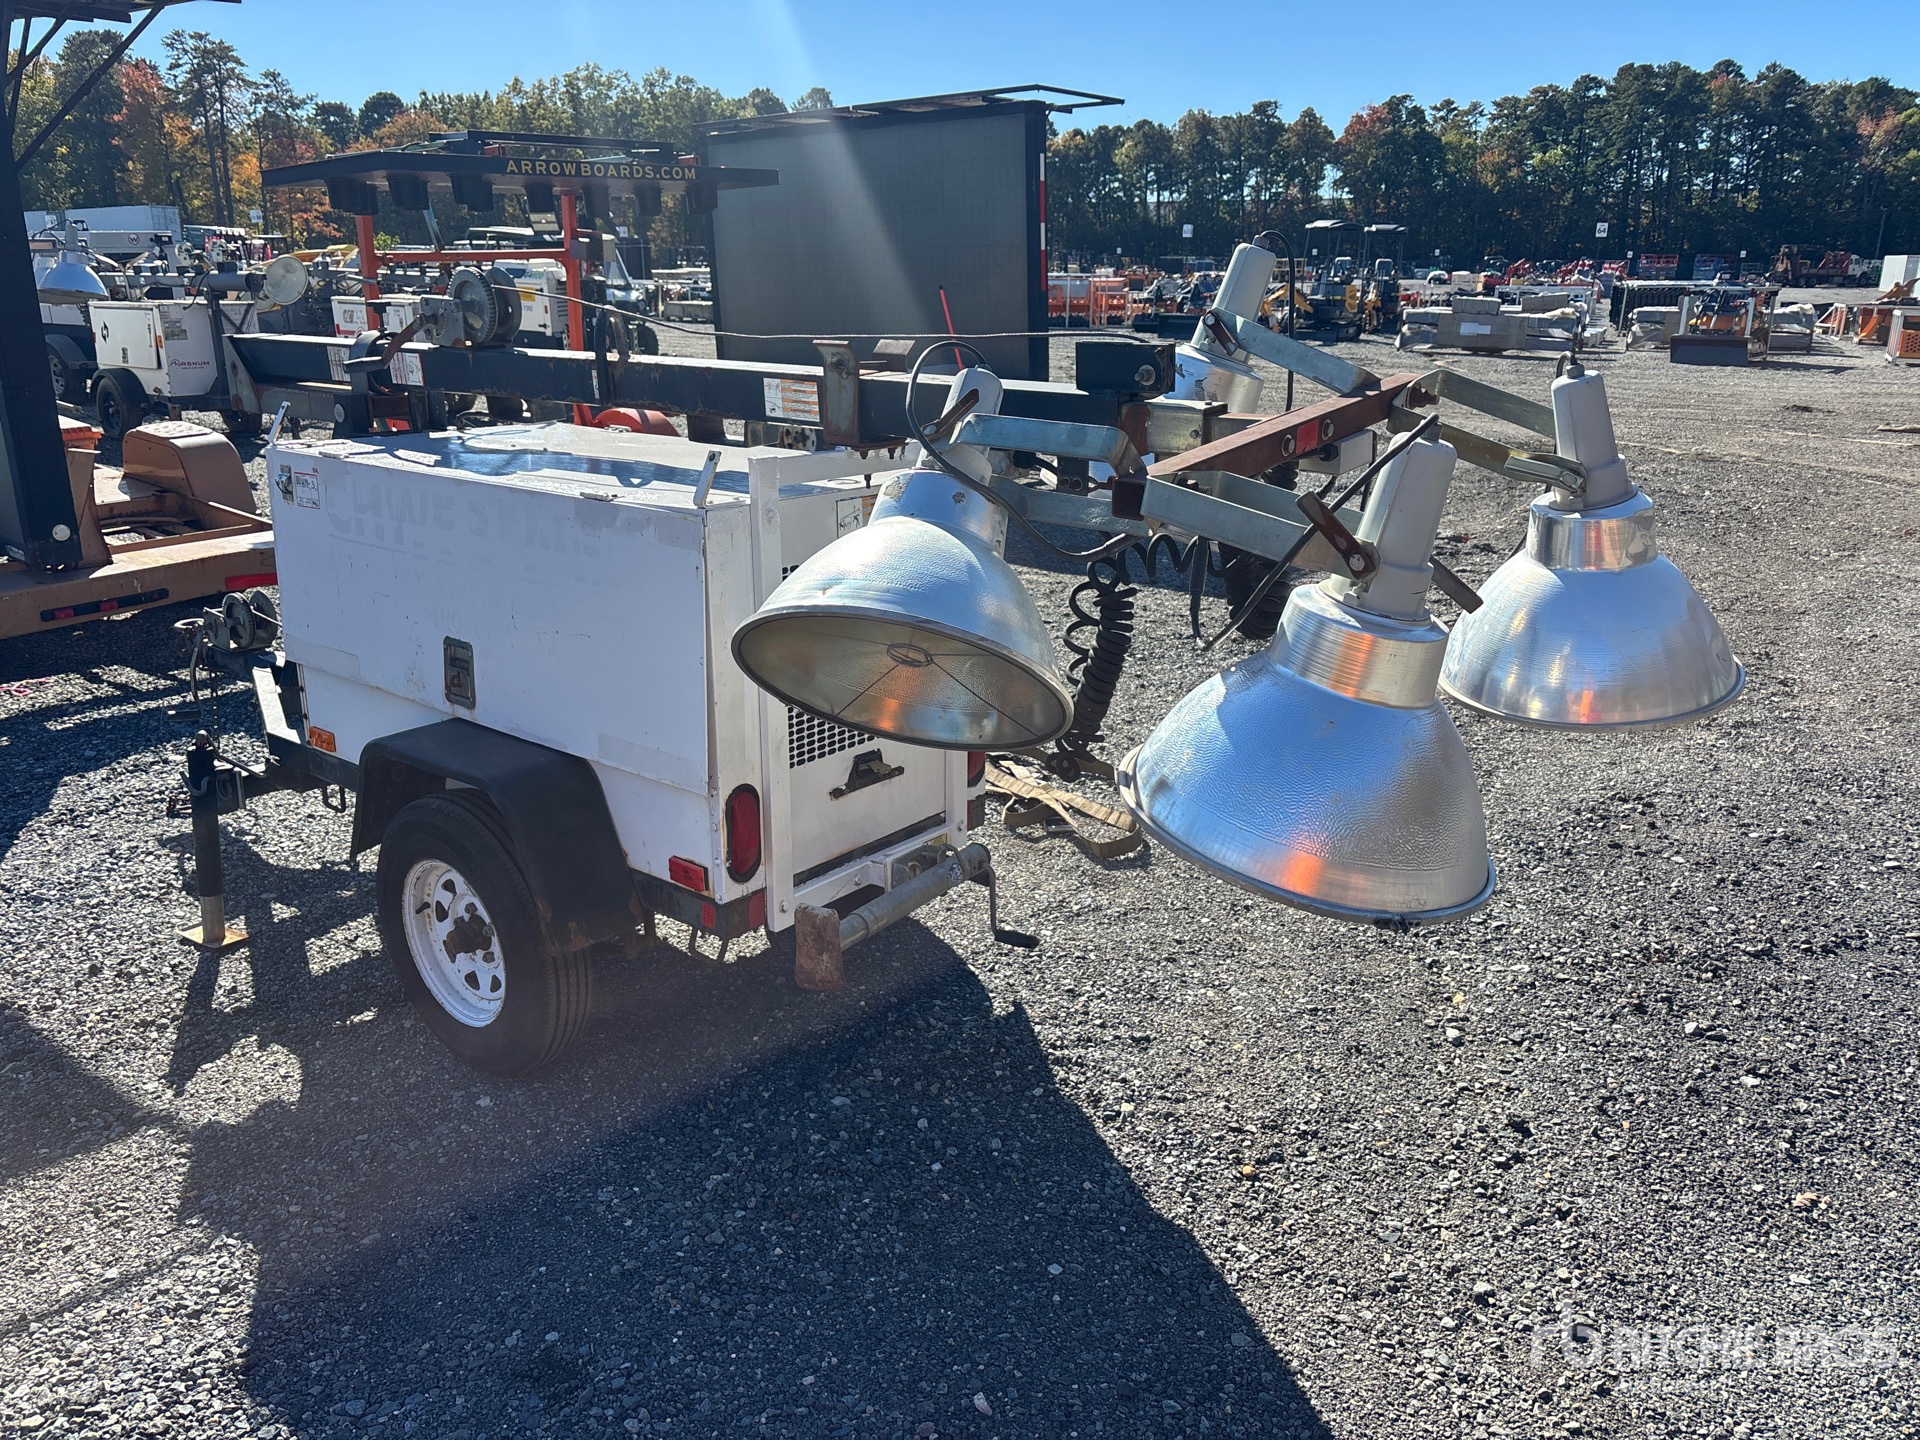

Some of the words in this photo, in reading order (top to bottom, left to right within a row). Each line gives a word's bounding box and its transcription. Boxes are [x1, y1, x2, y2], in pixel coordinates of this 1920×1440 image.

[506, 159, 697, 180] ARROWBOARDS.COM
[1597, 226, 1607, 235] 64
[169, 358, 210, 367] MAGNUM
